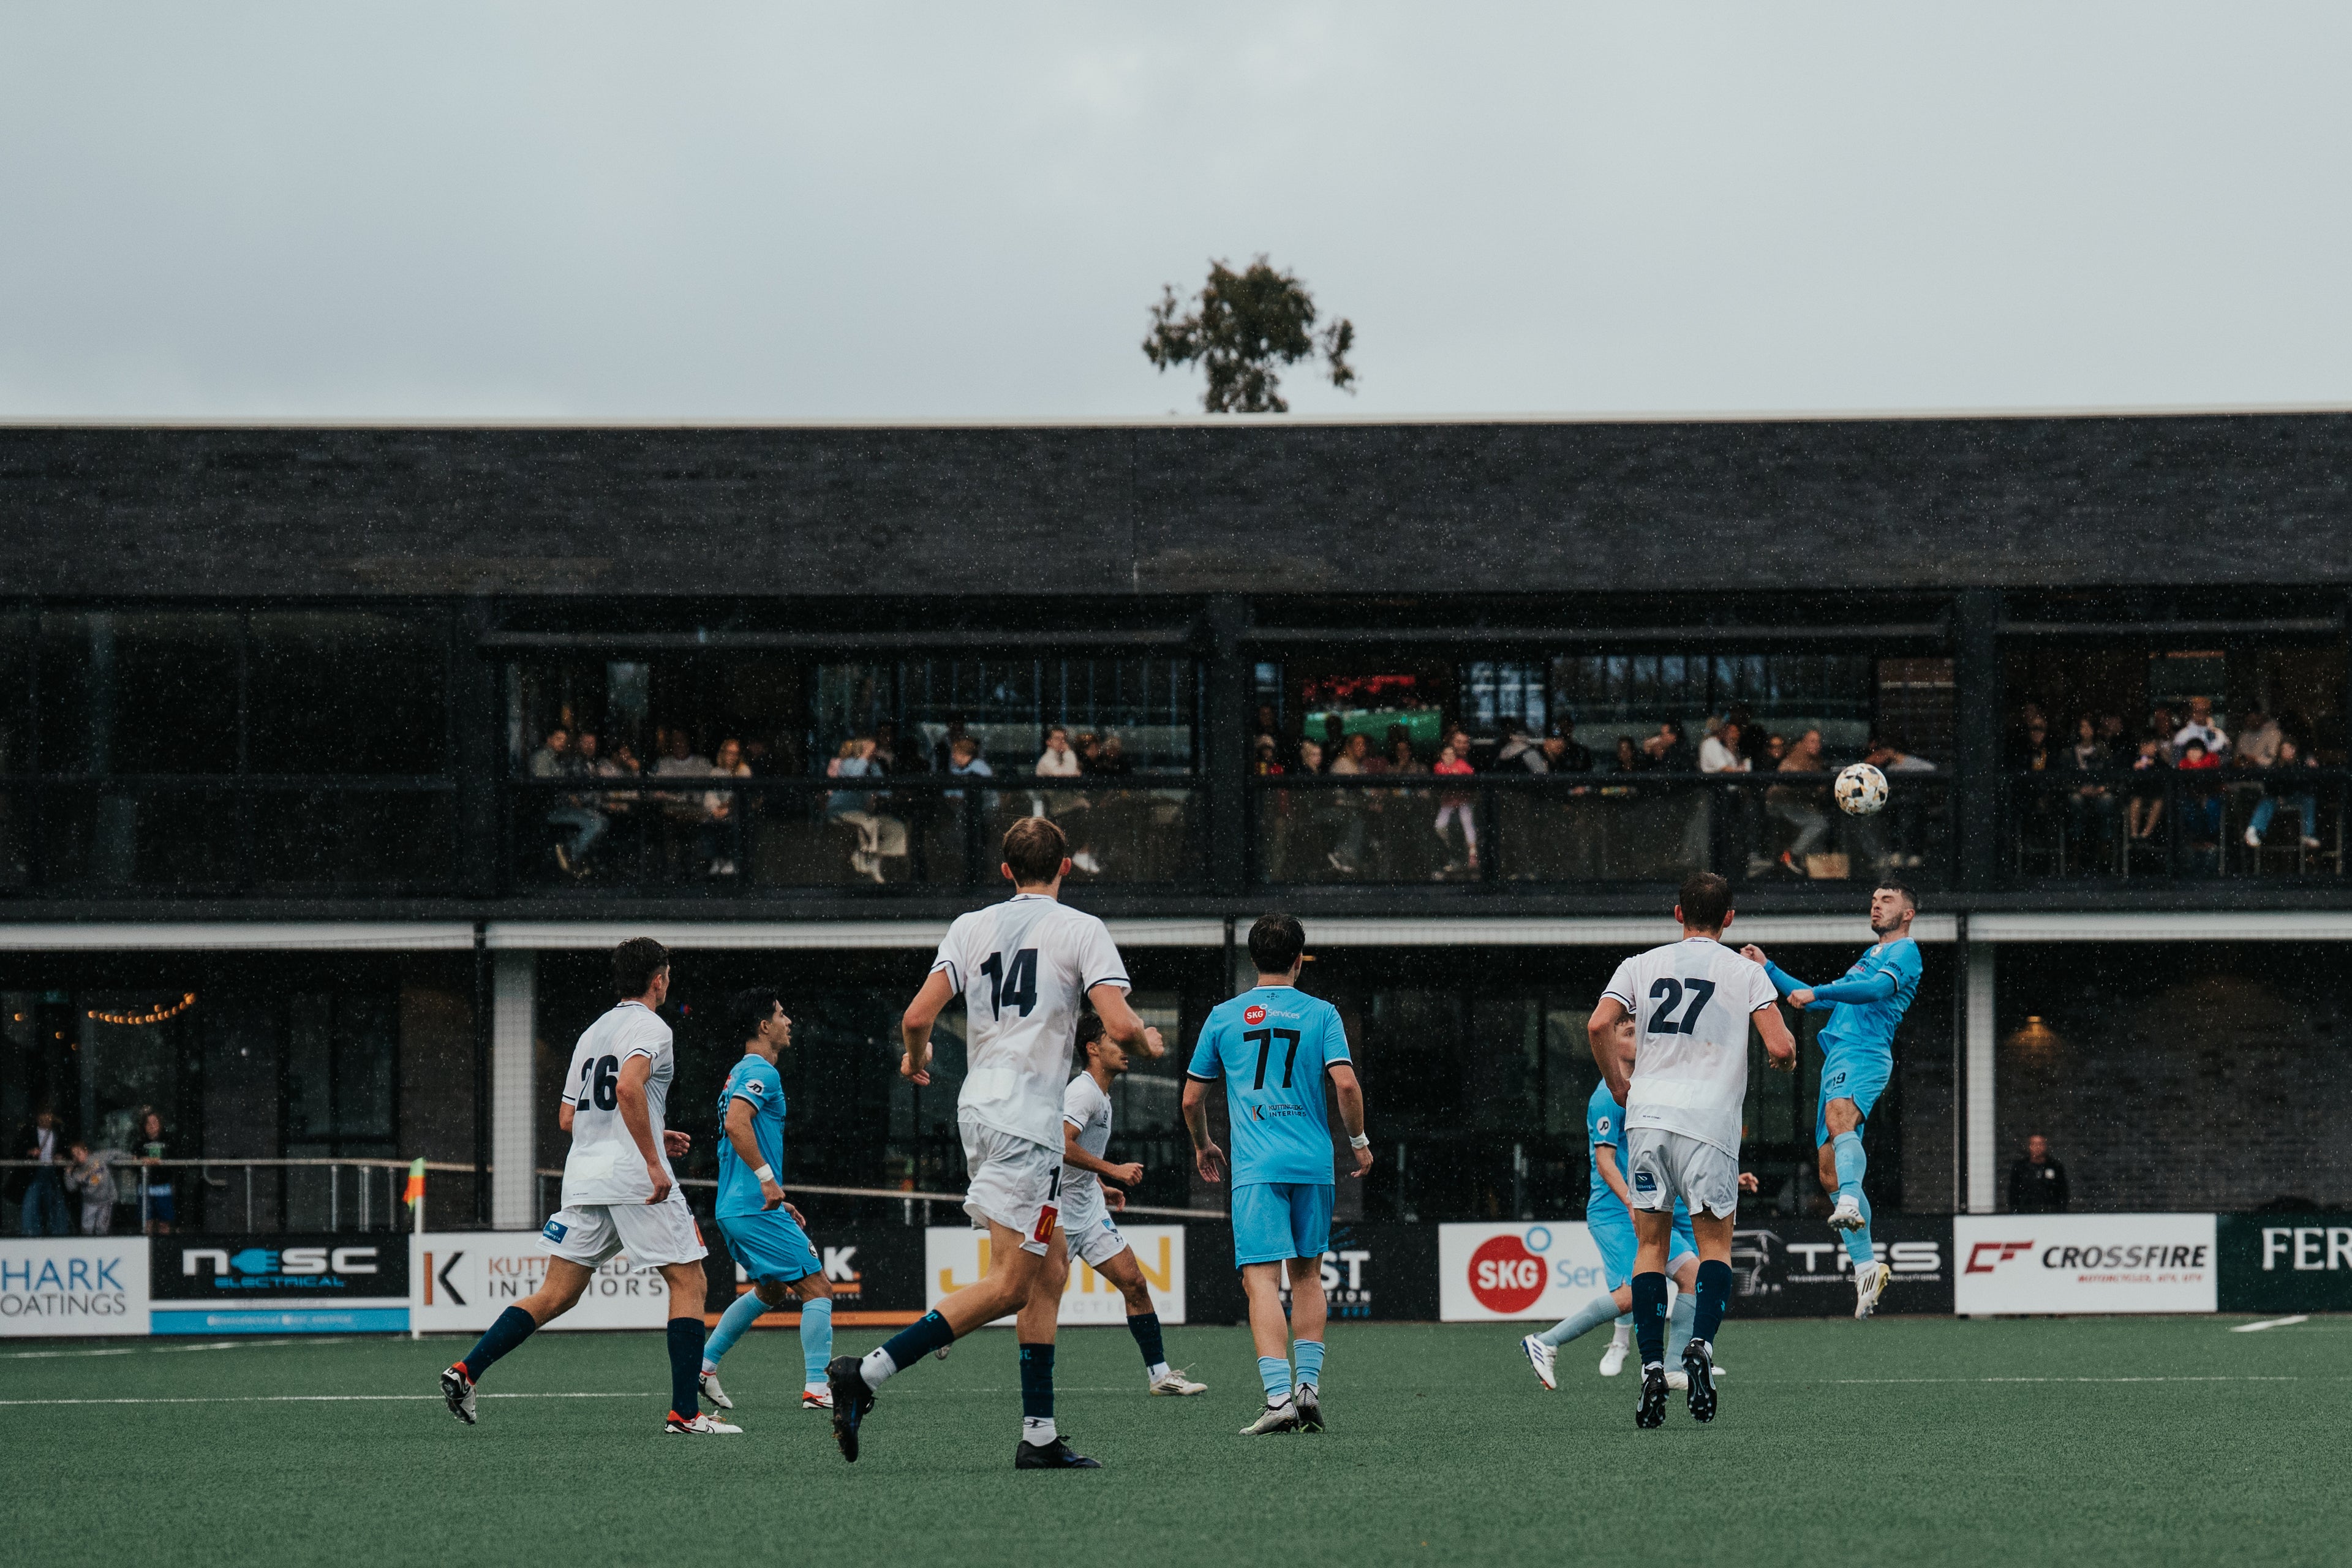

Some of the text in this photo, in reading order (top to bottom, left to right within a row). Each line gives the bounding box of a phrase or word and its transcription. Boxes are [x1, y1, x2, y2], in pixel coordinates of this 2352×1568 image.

[981, 948, 1038, 1022] 14
[1246, 1008, 1300, 1020] SKG Services
[1648, 978, 1716, 1035] 27
[1243, 1028, 1300, 1090] 77
[576, 1055, 619, 1111] 26
[1269, 1109, 1306, 1117] INTERIORS
[2043, 1245, 2208, 1268] CROSSFIRE
[2261, 1227, 2352, 1271] FER
[1, 1257, 124, 1291] HARK
[939, 1237, 1171, 1294] JIN
[1477, 1260, 1539, 1289] SKG
[214, 1276, 345, 1289] ELECTRICAL
[488, 1278, 663, 1297] INTIORS
[0, 1294, 126, 1316] OATINGS
